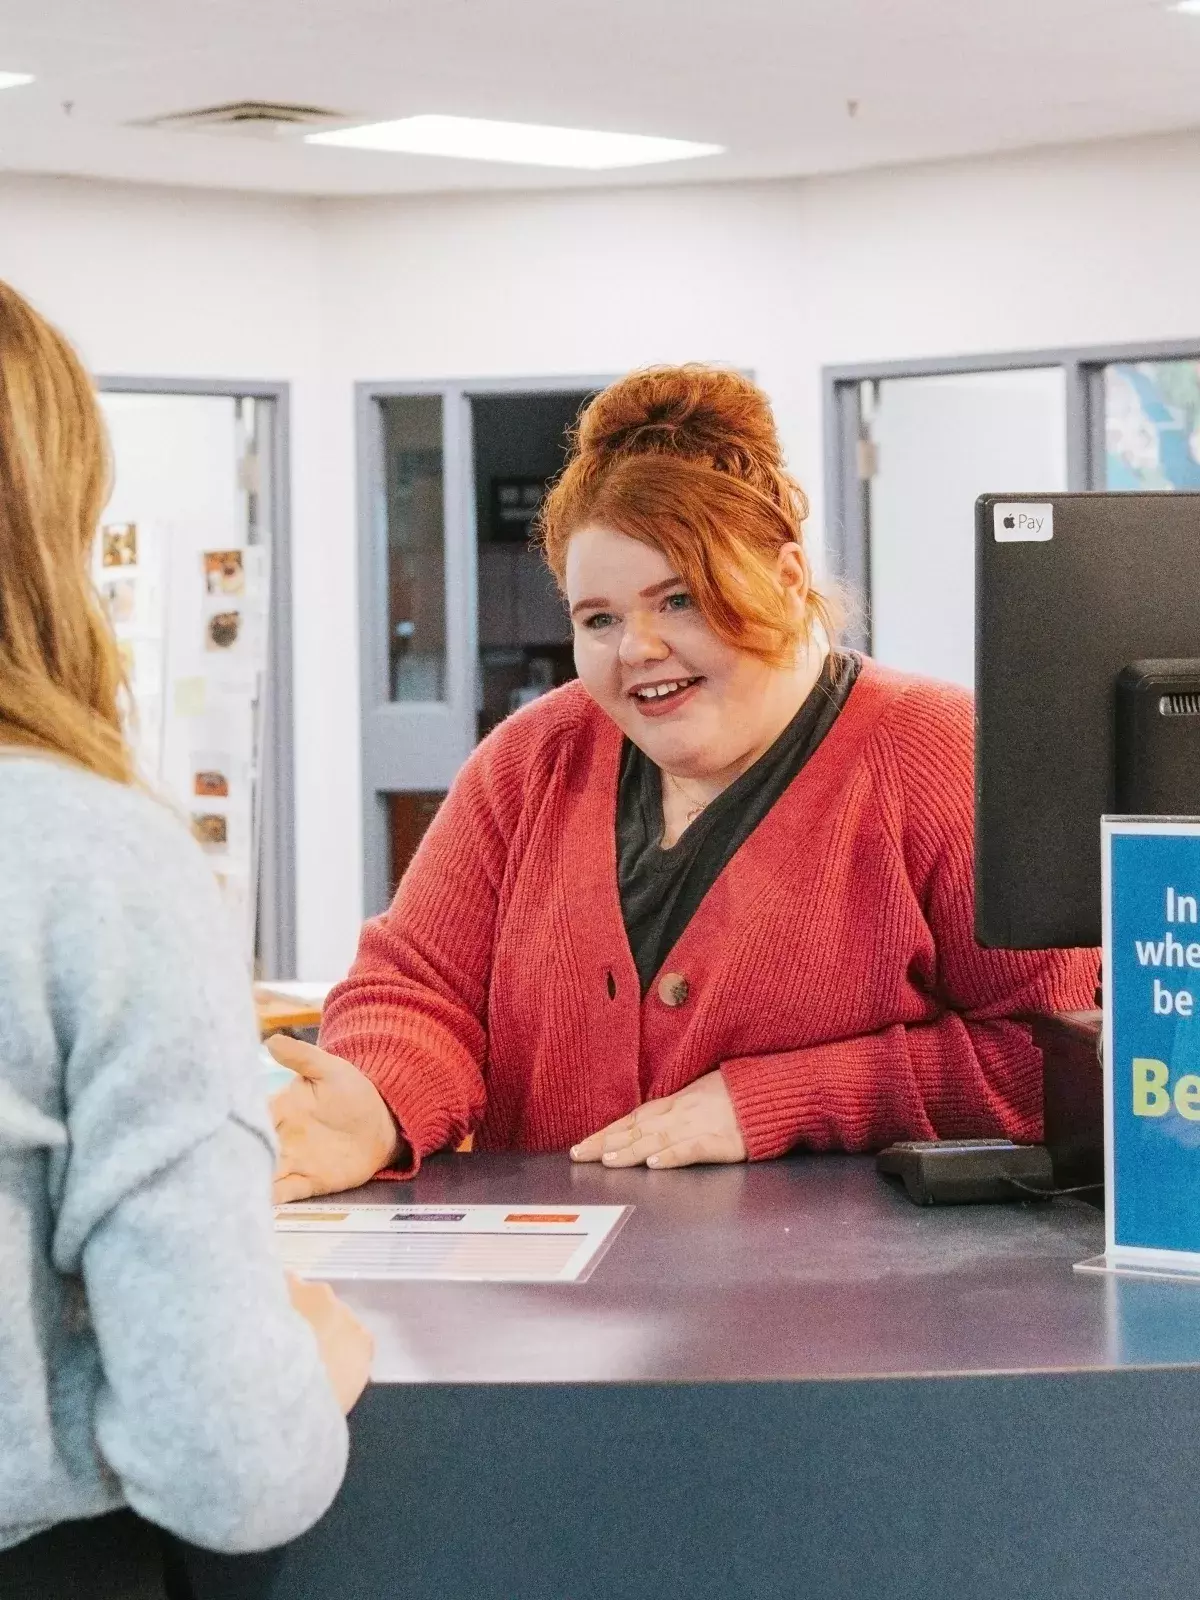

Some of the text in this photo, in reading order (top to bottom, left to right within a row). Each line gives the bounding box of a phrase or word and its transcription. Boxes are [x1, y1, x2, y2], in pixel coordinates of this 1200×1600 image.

[1018, 513, 1045, 534] Pay
[1166, 886, 1198, 924] In
[1135, 931, 1200, 968] whe
[1153, 979, 1193, 1016] be
[1132, 1057, 1200, 1121] Be
